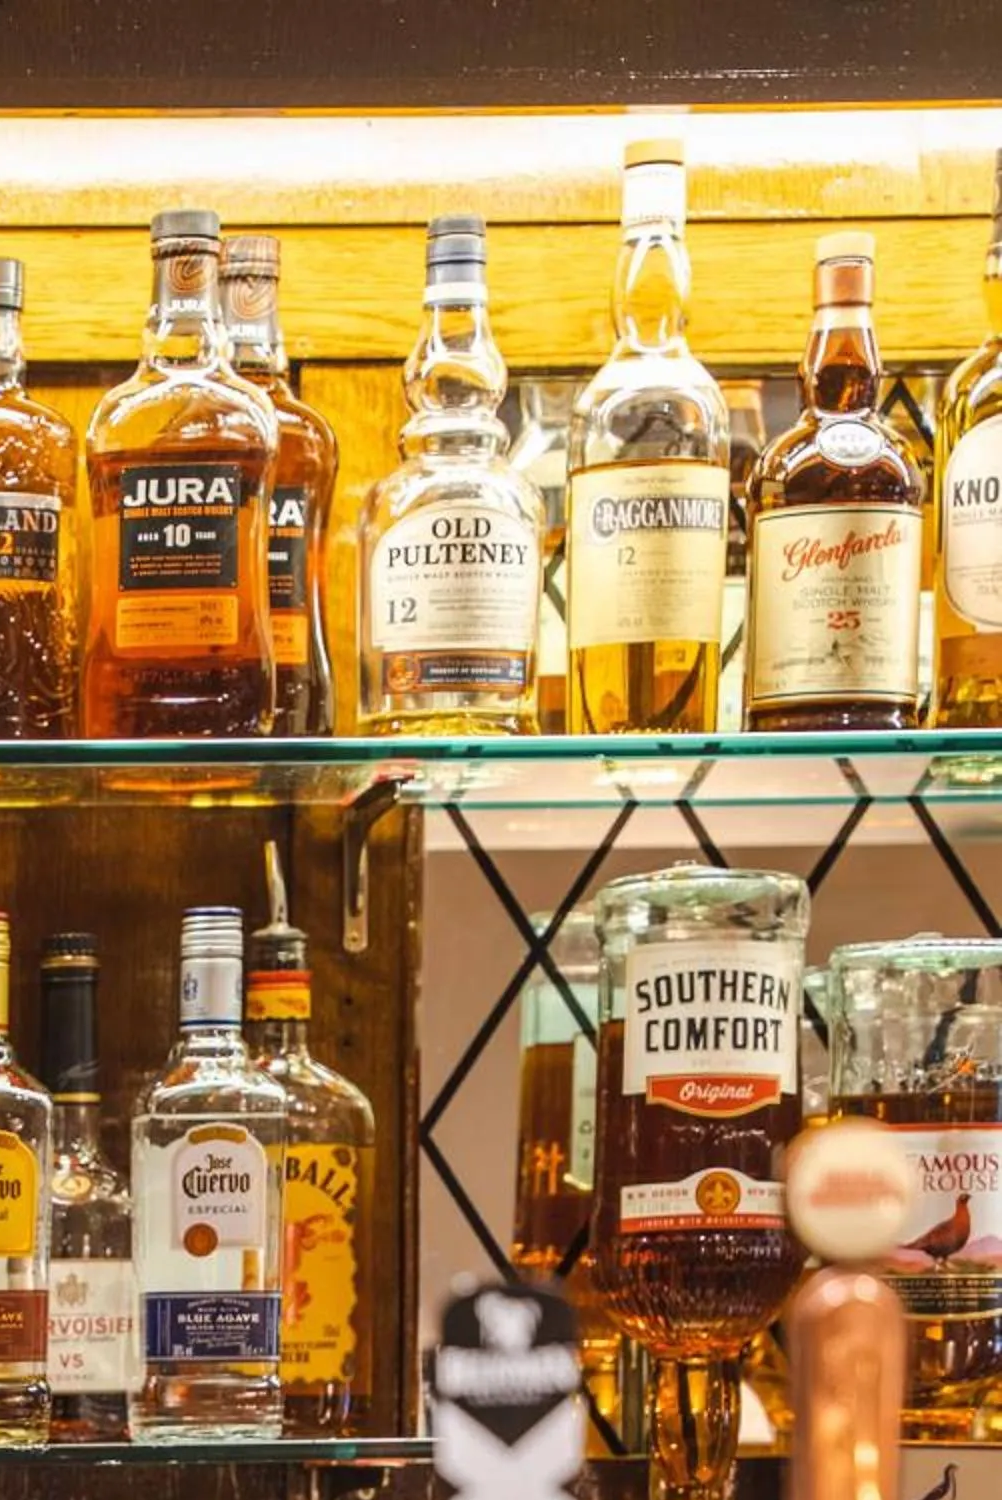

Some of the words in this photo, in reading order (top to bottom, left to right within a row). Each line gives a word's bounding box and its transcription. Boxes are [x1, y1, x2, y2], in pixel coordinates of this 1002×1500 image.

[122, 476, 235, 508] JURA
[163, 522, 191, 548] 10
[431, 516, 492, 539] OLD
[387, 542, 529, 568] PULTENEY
[616, 546, 637, 567] 12
[782, 519, 906, 582] Glenfarcla
[385, 596, 418, 625] 12
[827, 610, 861, 631] 25
[635, 968, 792, 1014] SOUTHERN
[645, 1016, 783, 1053] COMFORT
[679, 1080, 756, 1105] Original
[182, 1166, 251, 1200] Cuervo
[187, 1204, 248, 1215] ESPECIAL
[177, 1313, 213, 1324] BLUE
[216, 1312, 260, 1324] AGAVE
[58, 1352, 85, 1369] VS
